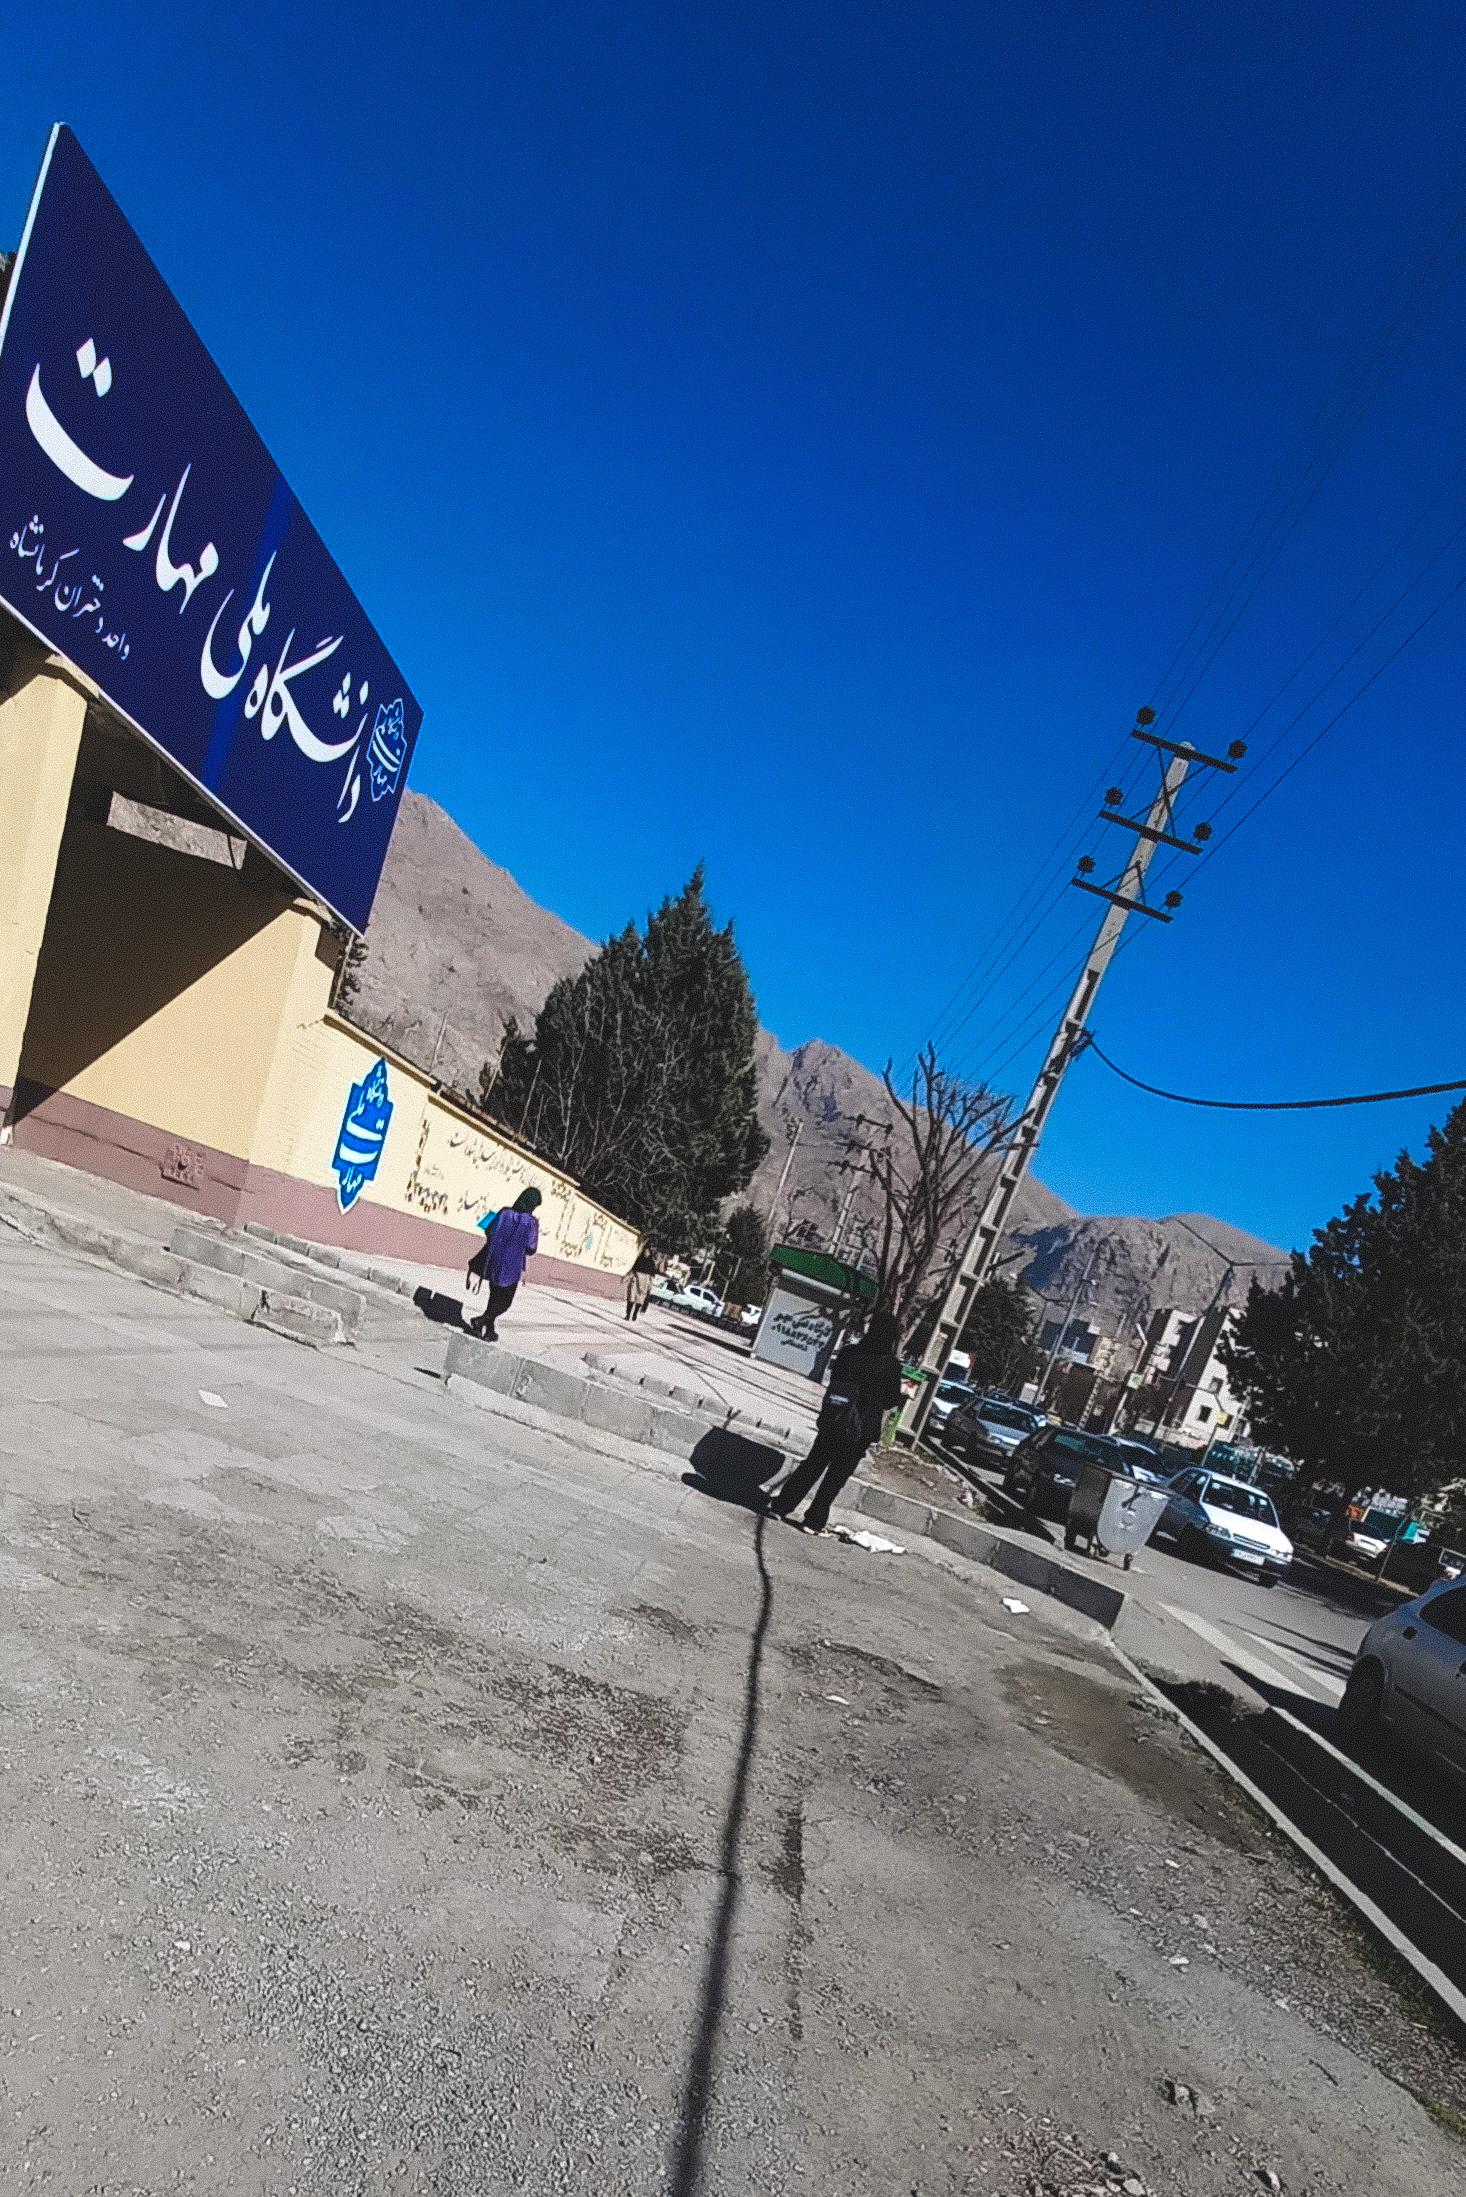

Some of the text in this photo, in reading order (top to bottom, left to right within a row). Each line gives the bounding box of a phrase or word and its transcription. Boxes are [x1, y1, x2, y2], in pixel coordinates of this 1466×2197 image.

[9, 514, 131, 661] واحد دختران کرمانشاه
[25, 337, 369, 824] دانشگاه ملی مهارت
